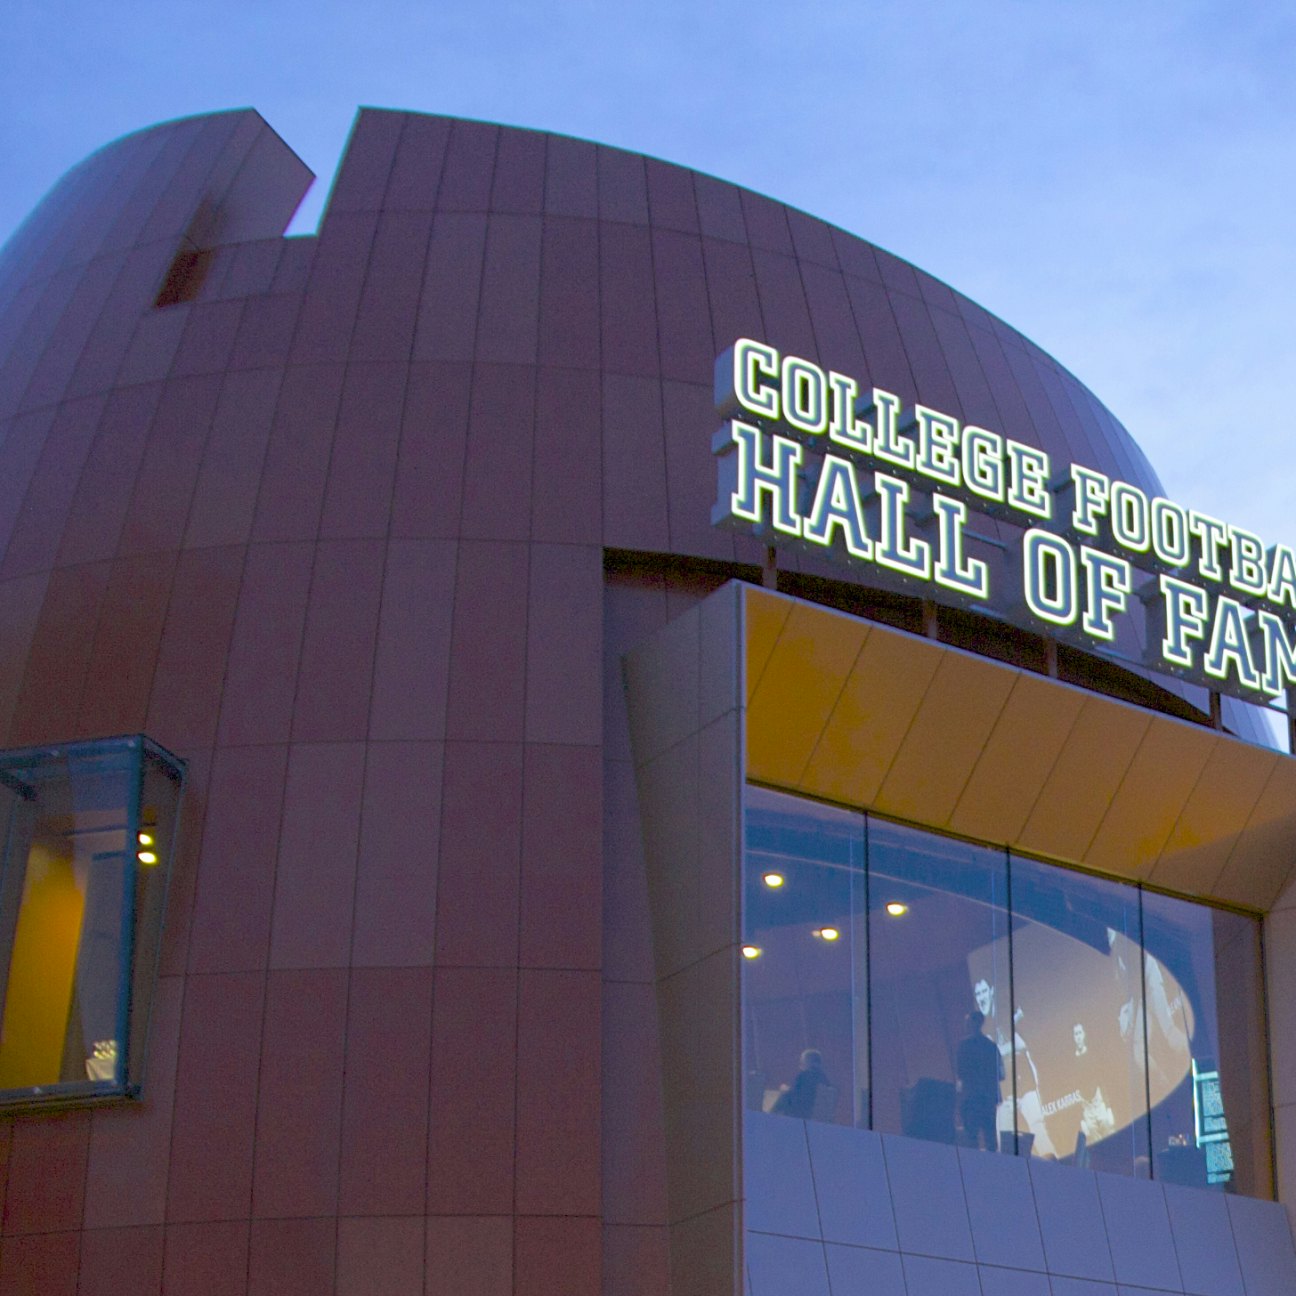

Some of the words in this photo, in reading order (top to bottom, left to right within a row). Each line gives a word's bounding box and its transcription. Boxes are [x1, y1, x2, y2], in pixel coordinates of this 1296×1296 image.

[733, 338, 1051, 519] COLLEGE
[731, 419, 988, 599] HALL
[1023, 527, 1131, 641] OF
